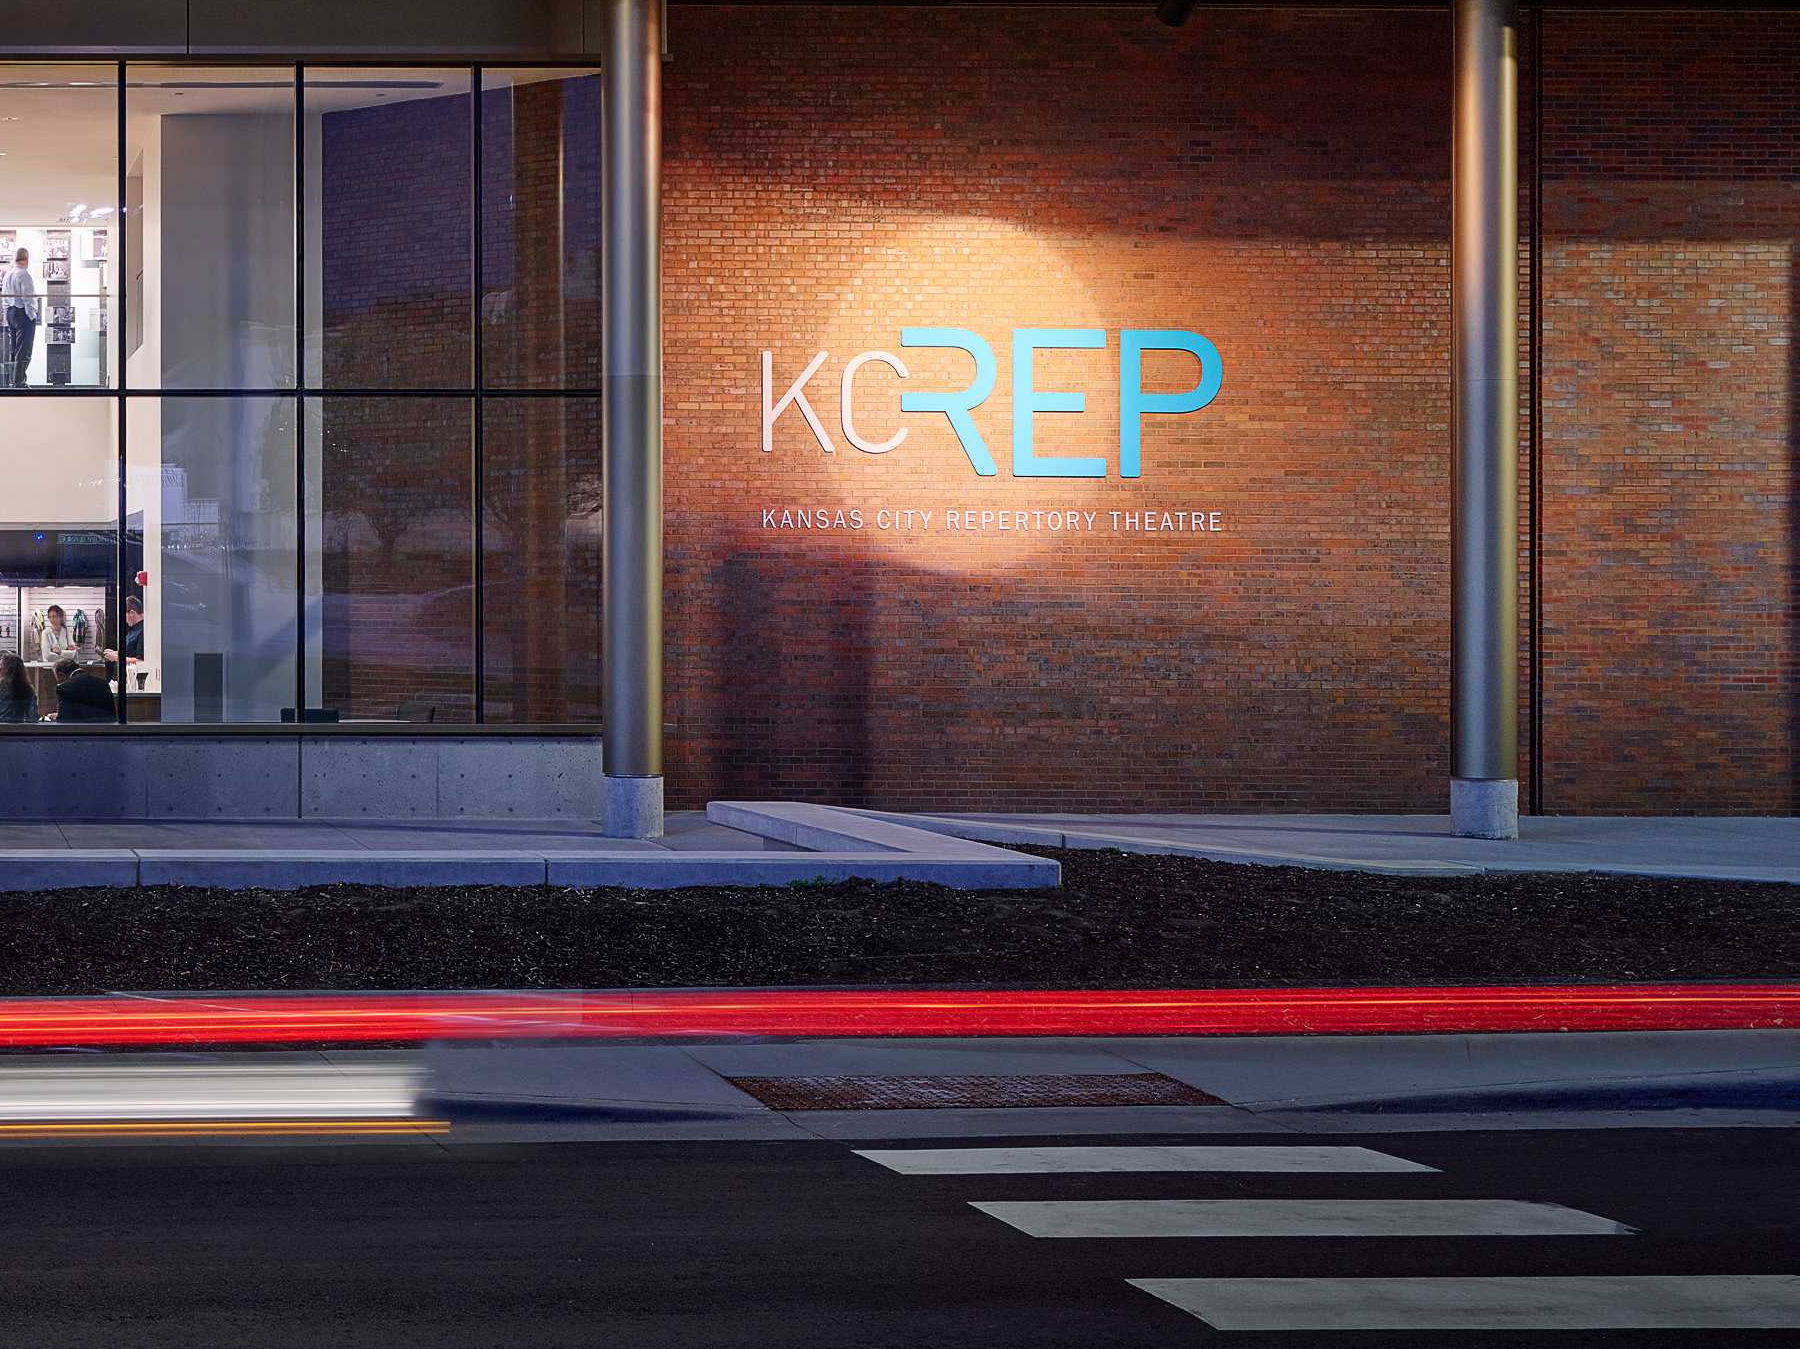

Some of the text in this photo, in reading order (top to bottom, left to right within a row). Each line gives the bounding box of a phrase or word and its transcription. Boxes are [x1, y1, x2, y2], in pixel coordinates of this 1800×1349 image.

[762, 508, 1222, 532] KANSAS CITY REPERTORY THEATRE
